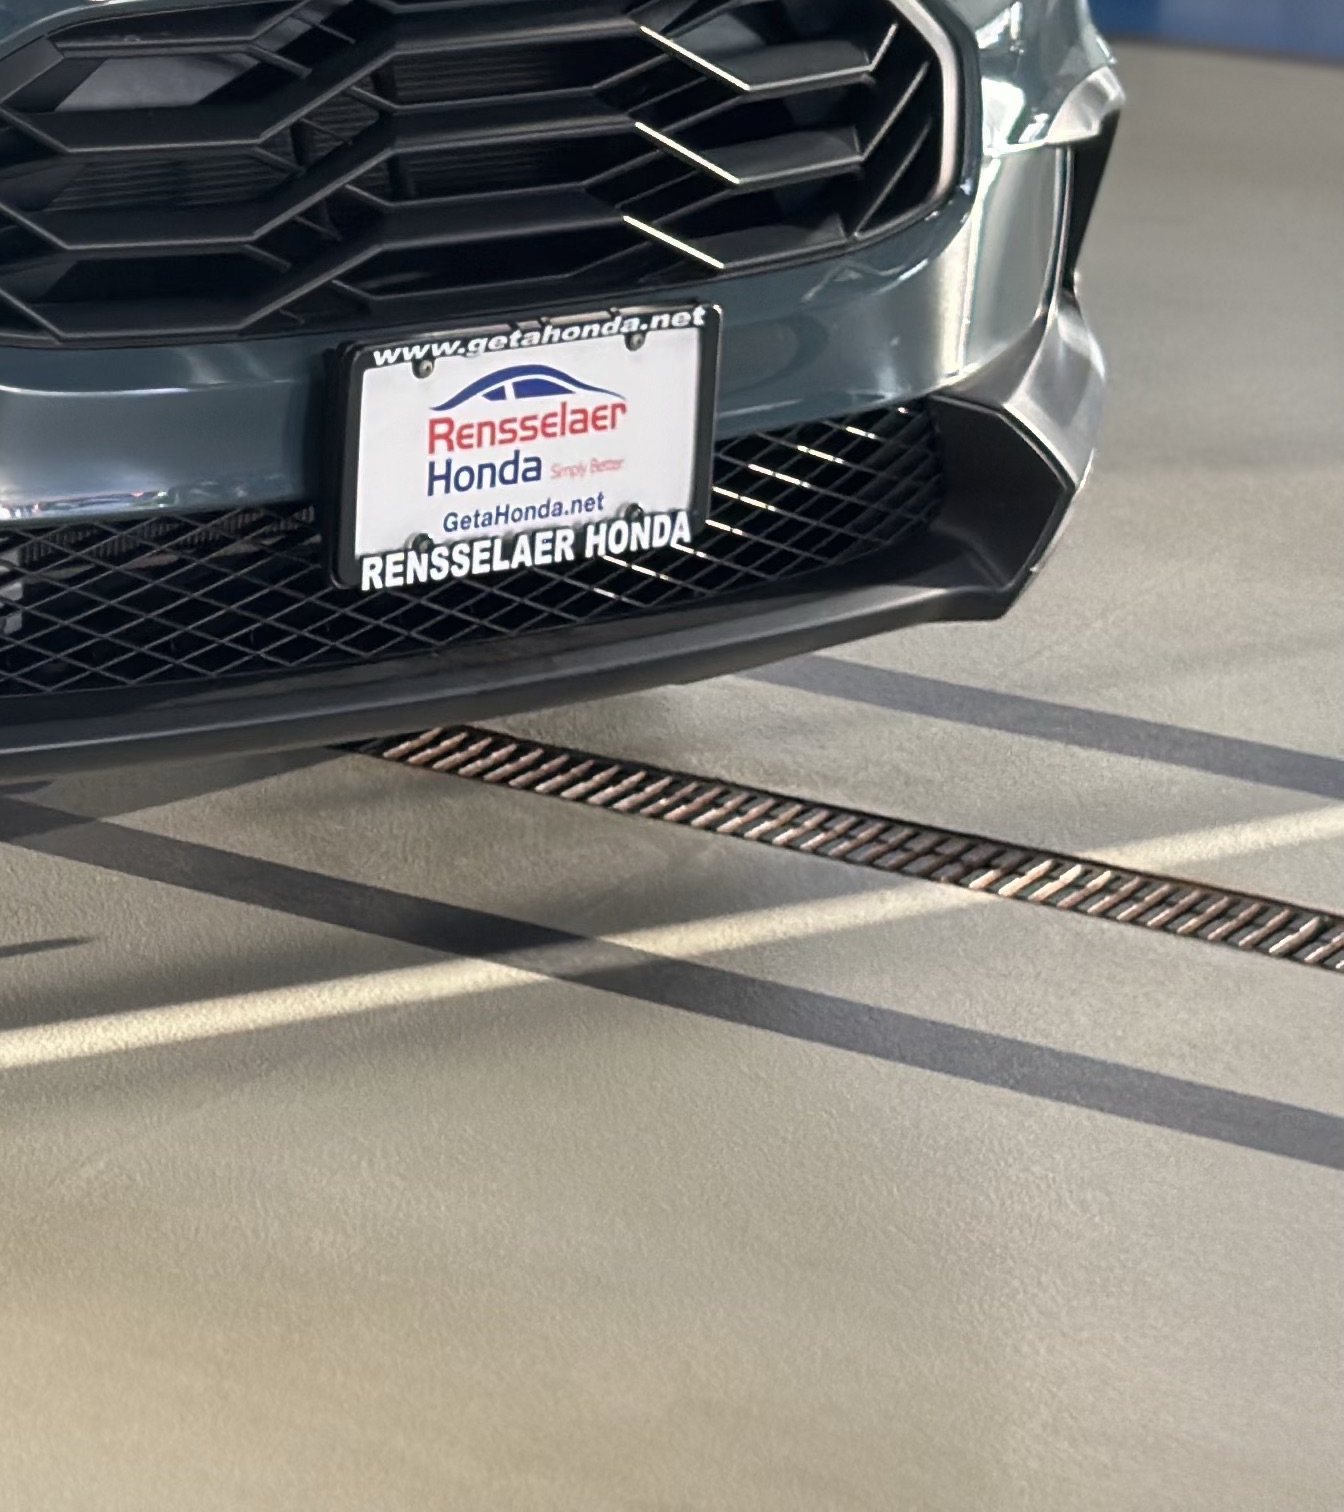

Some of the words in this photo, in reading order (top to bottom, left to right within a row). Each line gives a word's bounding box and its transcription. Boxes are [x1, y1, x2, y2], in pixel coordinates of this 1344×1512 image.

[373, 305, 707, 366] www.getahonda.net
[428, 402, 627, 454] Rensselaer
[427, 449, 542, 496] Honda
[443, 491, 605, 533] GetaHonda.net
[362, 528, 575, 591] RENSSELAER
[585, 511, 692, 559] HONDA
